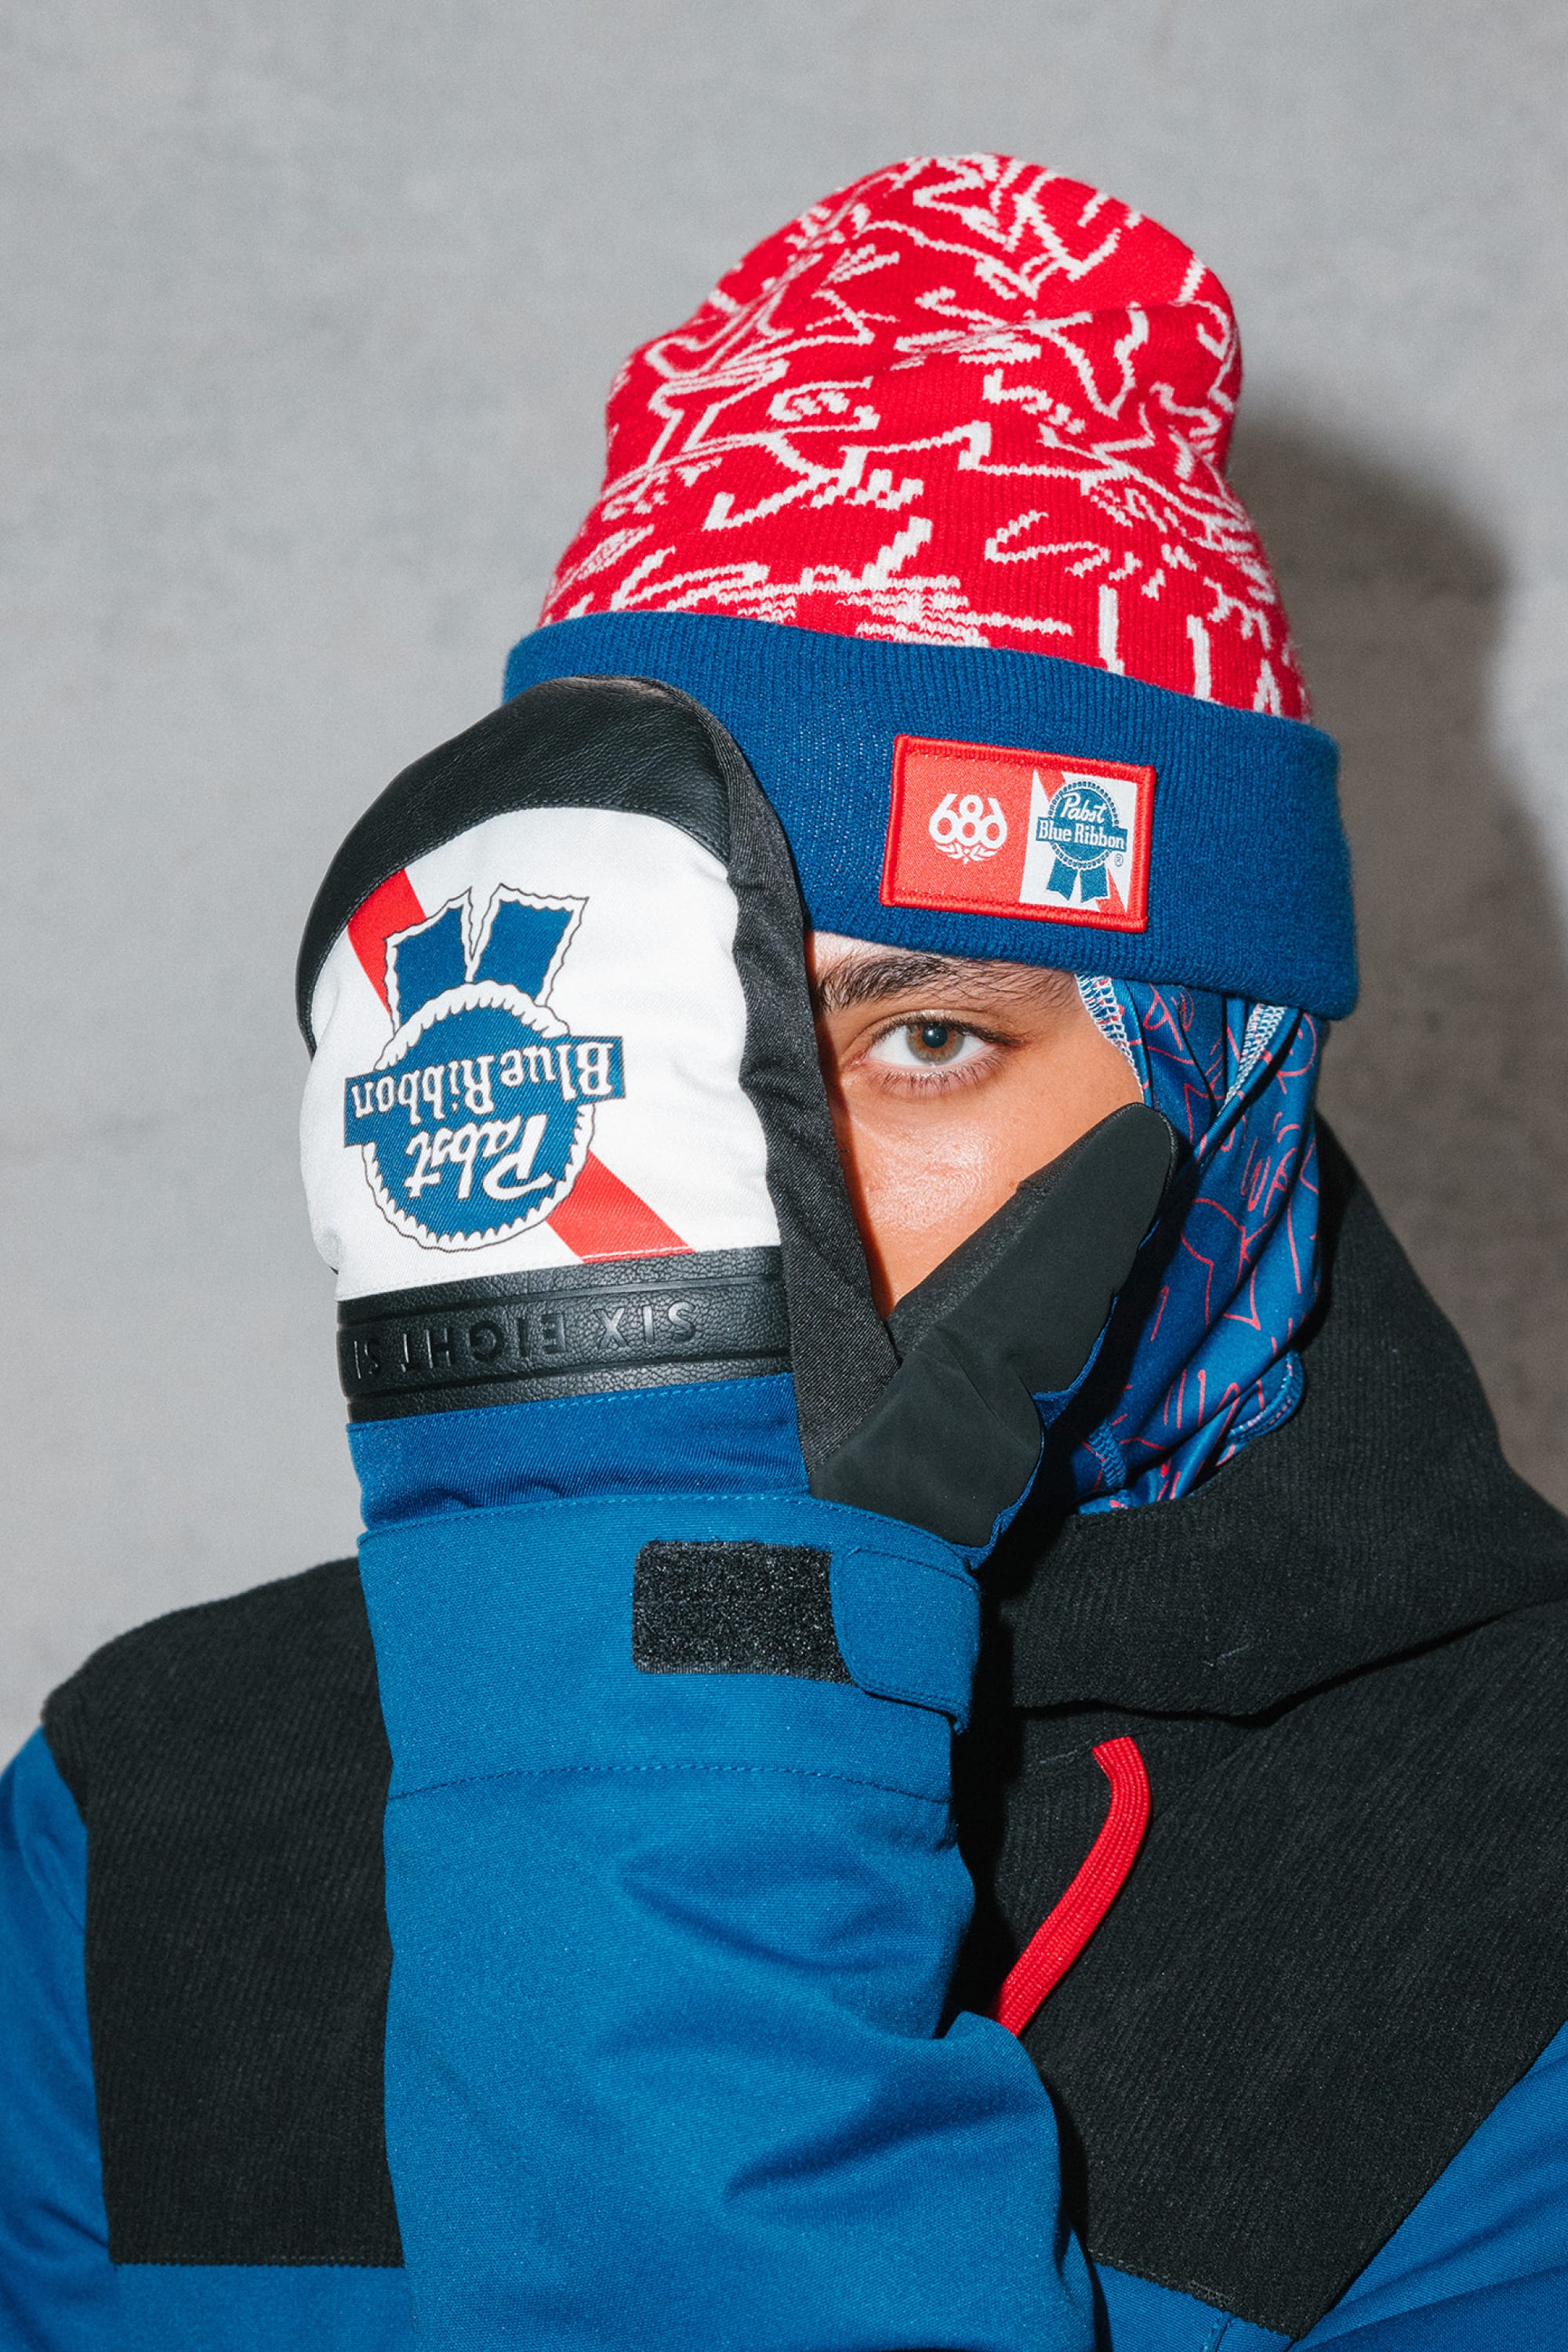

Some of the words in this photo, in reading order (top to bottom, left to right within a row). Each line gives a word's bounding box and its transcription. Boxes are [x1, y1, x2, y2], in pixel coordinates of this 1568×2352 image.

[928, 793, 1007, 849] 686
[1039, 820, 1071, 842] Blue
[1074, 825, 1125, 849] Ribbon
[1060, 793, 1106, 824] Pabst
[350, 1054, 495, 1125] Ribbon
[499, 1042, 614, 1102] Blue
[405, 1113, 553, 1200] Pabst
[400, 1312, 569, 1374] EIGHT
[594, 1301, 698, 1351] SIX
